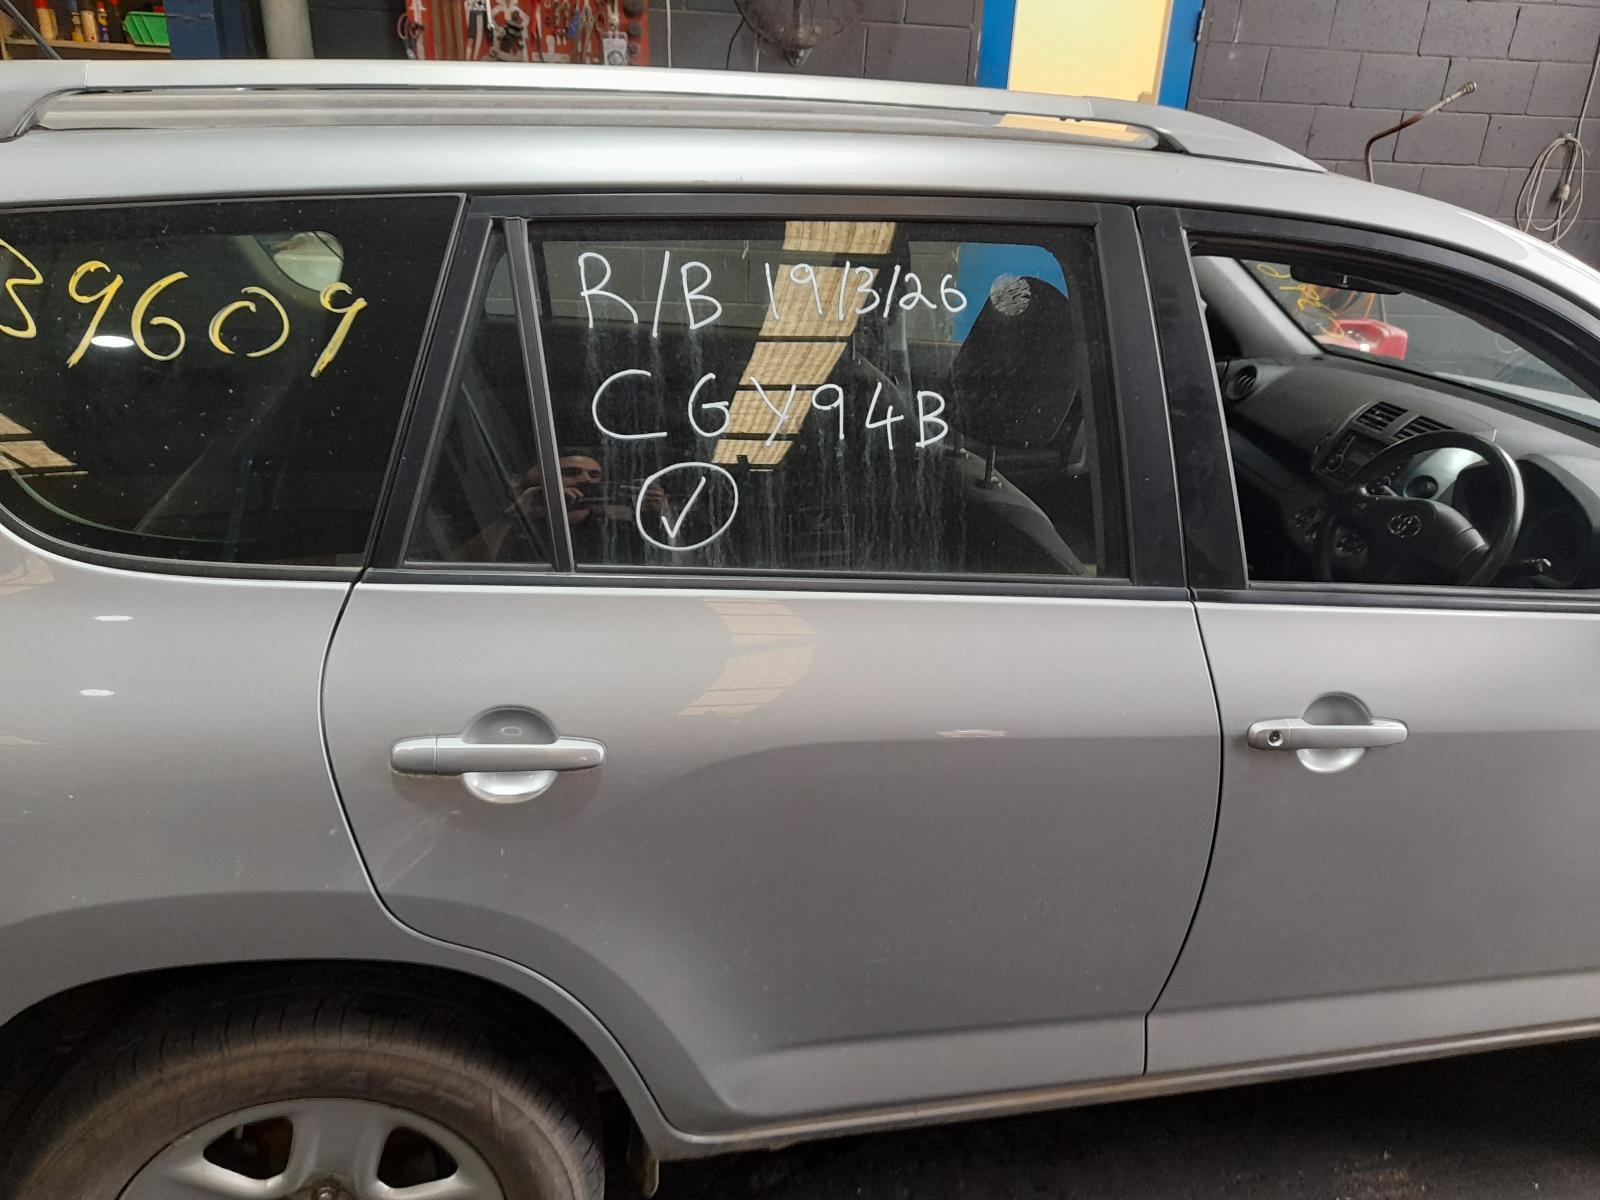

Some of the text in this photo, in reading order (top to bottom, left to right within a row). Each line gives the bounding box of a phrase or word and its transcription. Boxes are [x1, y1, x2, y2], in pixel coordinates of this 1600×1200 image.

[578, 251, 968, 338] R/B 19/3/26
[592, 369, 949, 450] CGY94B
